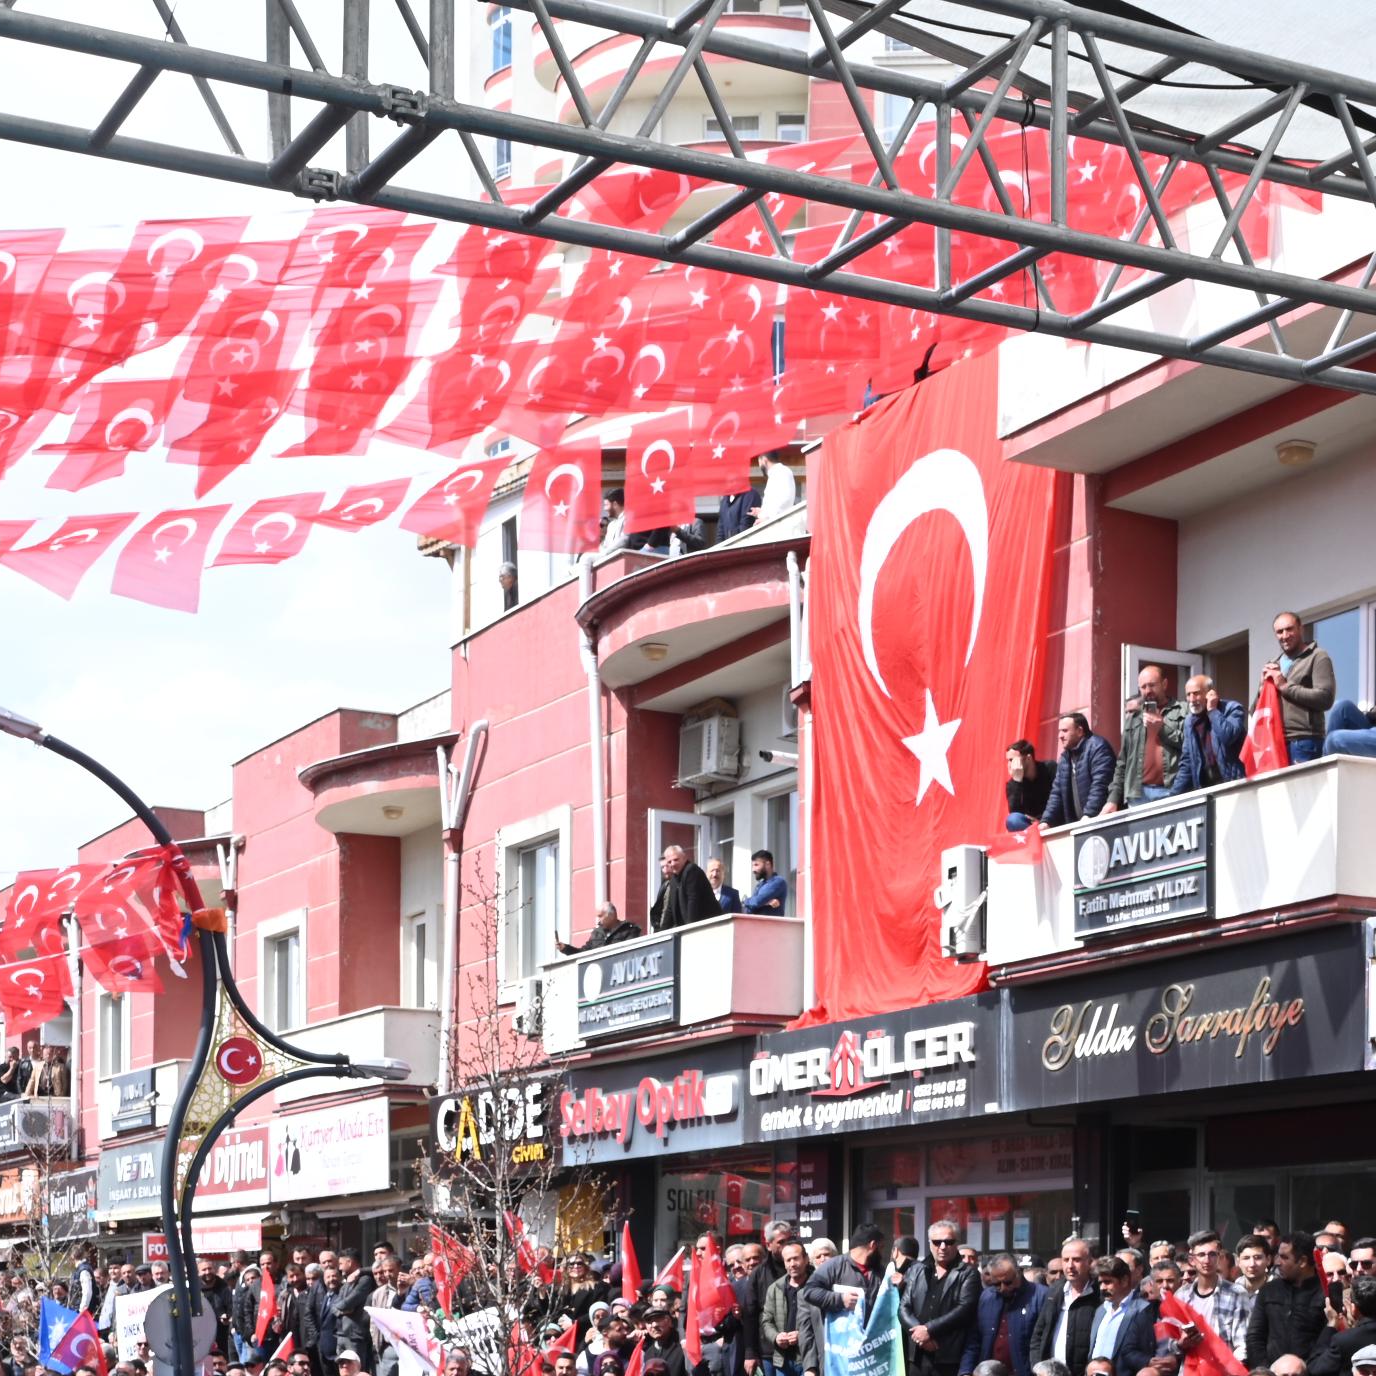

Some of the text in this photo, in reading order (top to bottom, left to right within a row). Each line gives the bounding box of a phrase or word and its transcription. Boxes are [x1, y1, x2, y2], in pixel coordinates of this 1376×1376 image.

[1109, 817, 1204, 868] AVUKAT
[1079, 876, 1198, 916] Fatih Mehmet YILDIZ
[609, 950, 664, 986] AVUKAT
[1145, 976, 1304, 1058] Sarrafiye
[749, 1021, 976, 1097] ÖMER ÖLÇER
[559, 1068, 706, 1145] Selbay Optik
[760, 1106, 801, 1132] emlak
[803, 1107, 813, 1127] &
